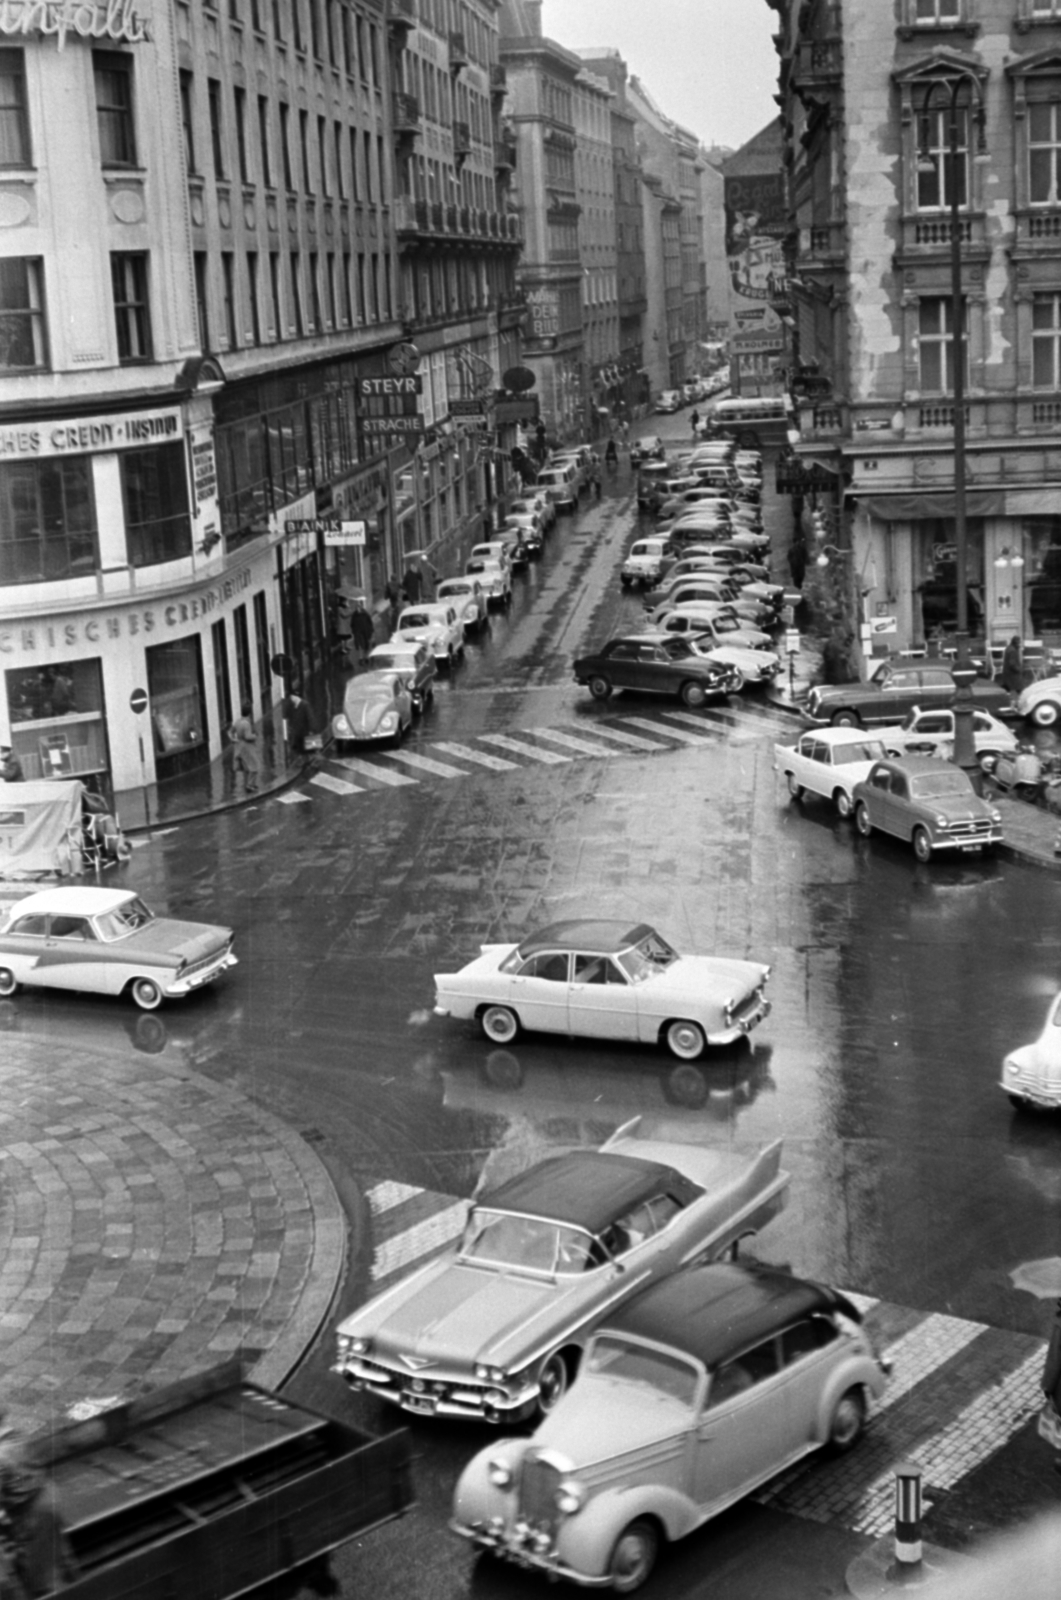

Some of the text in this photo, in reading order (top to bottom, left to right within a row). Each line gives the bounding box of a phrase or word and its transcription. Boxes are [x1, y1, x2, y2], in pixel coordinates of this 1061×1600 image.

[362, 377, 416, 394] STEYR
[362, 418, 421, 432] STRACHE
[287, 520, 339, 533] BANK
